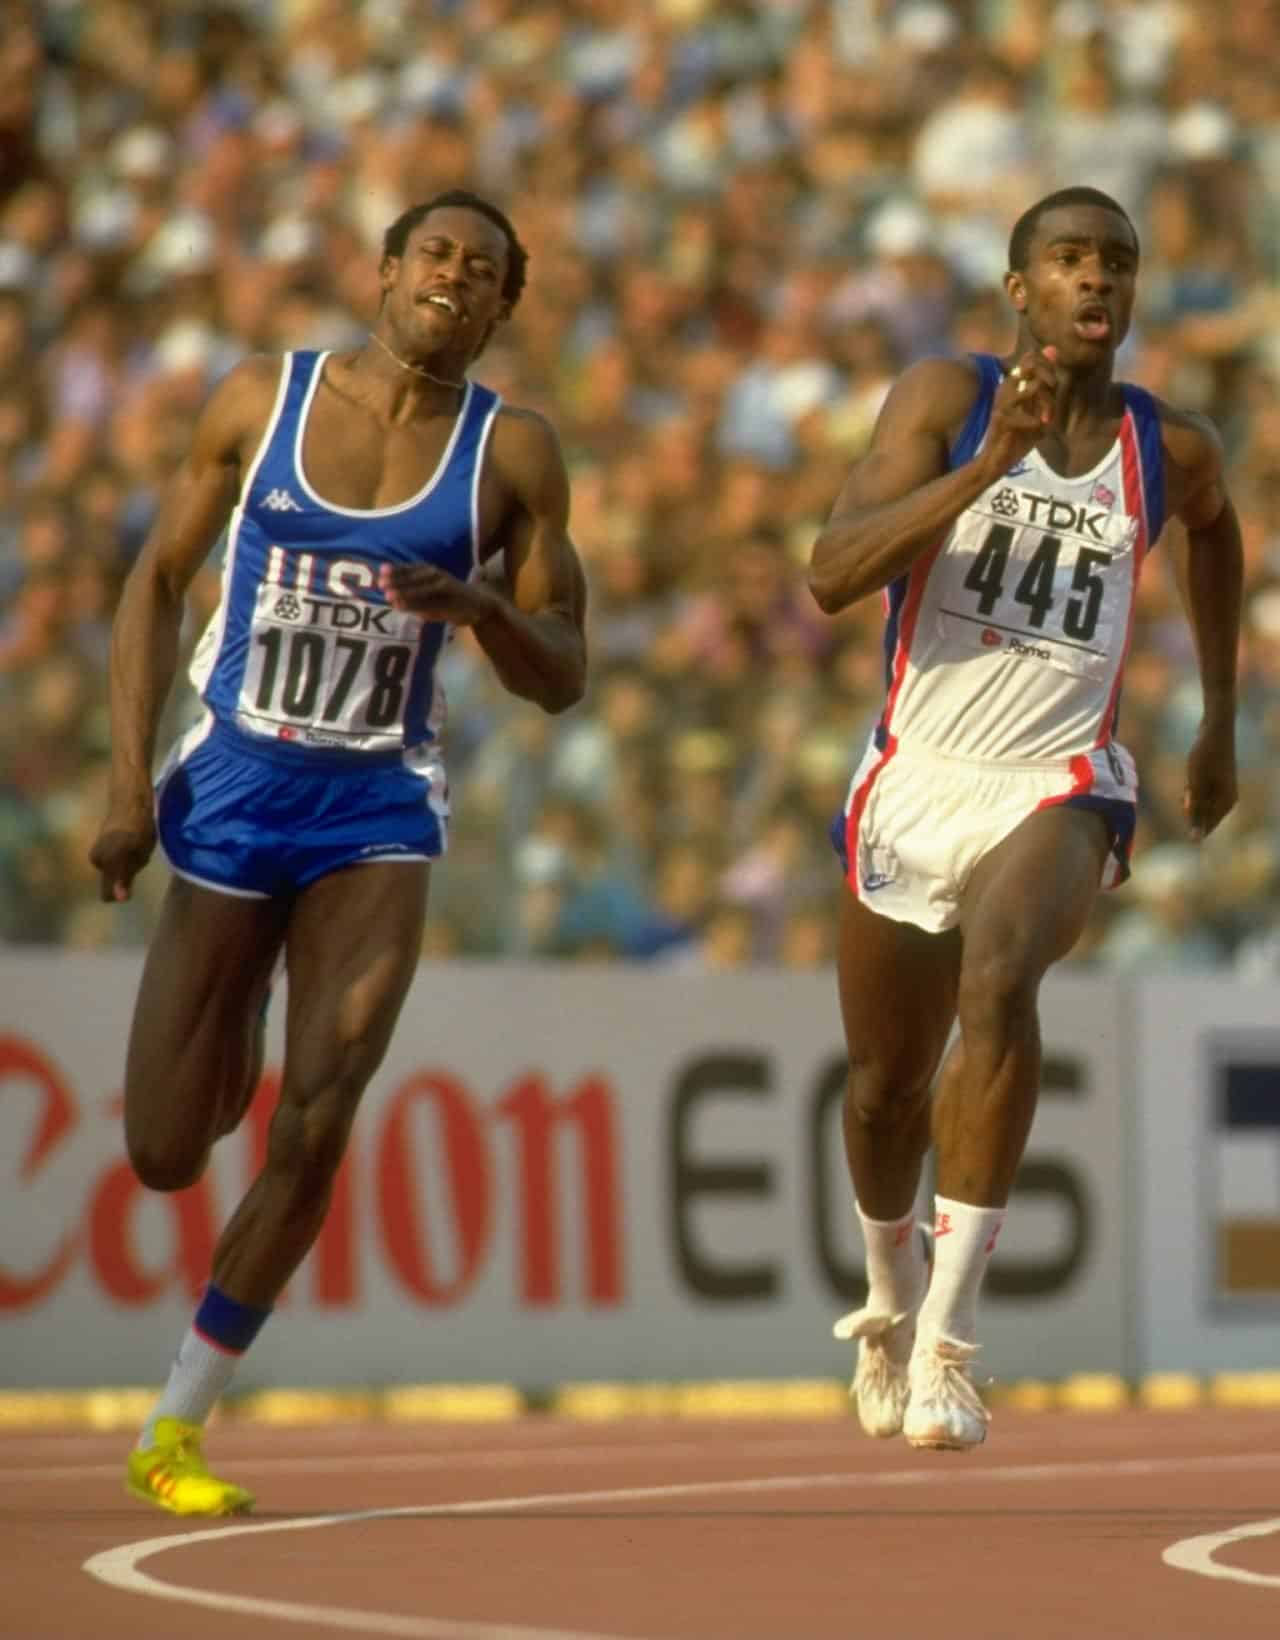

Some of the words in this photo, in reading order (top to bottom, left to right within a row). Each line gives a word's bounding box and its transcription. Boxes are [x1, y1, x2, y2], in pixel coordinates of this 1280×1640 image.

[1021, 492, 1108, 540] TDK
[963, 524, 1112, 642] 445
[302, 598, 393, 634] TDK
[1008, 638, 1050, 661] Roma
[254, 626, 410, 728] 1078
